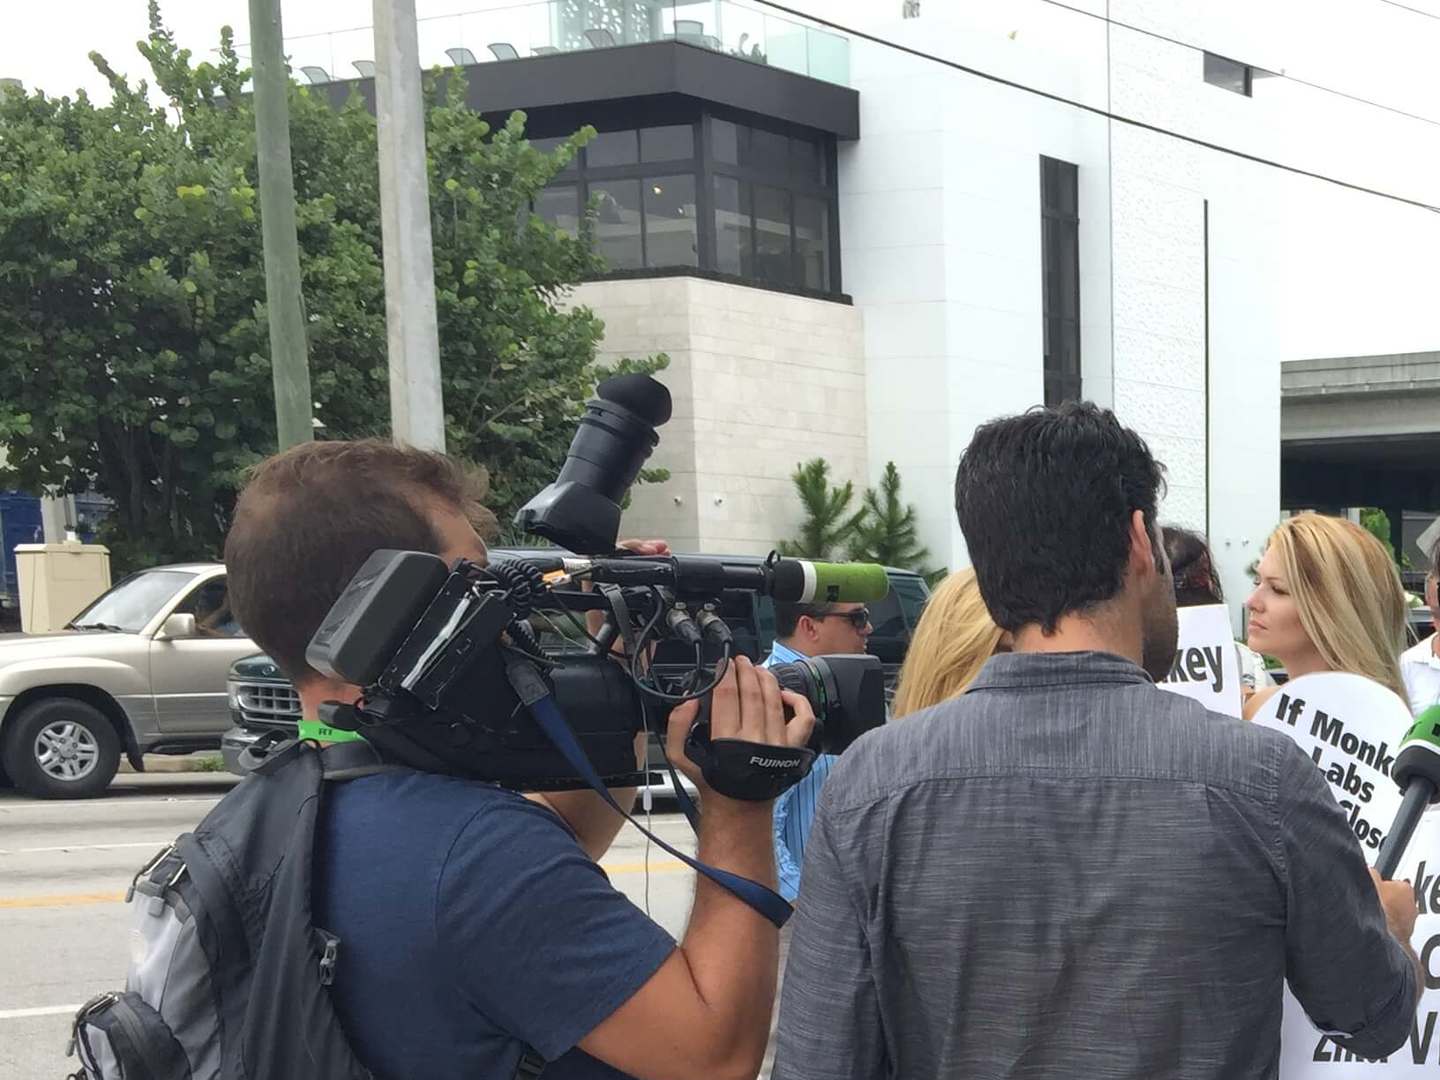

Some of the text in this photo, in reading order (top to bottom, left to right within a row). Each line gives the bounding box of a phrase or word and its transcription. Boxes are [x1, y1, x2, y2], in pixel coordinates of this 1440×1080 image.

[1166, 646, 1223, 692] key
[749, 755, 801, 768] FUJINON
[1275, 694, 1400, 790] If Monk
[1339, 800, 1388, 852] los
